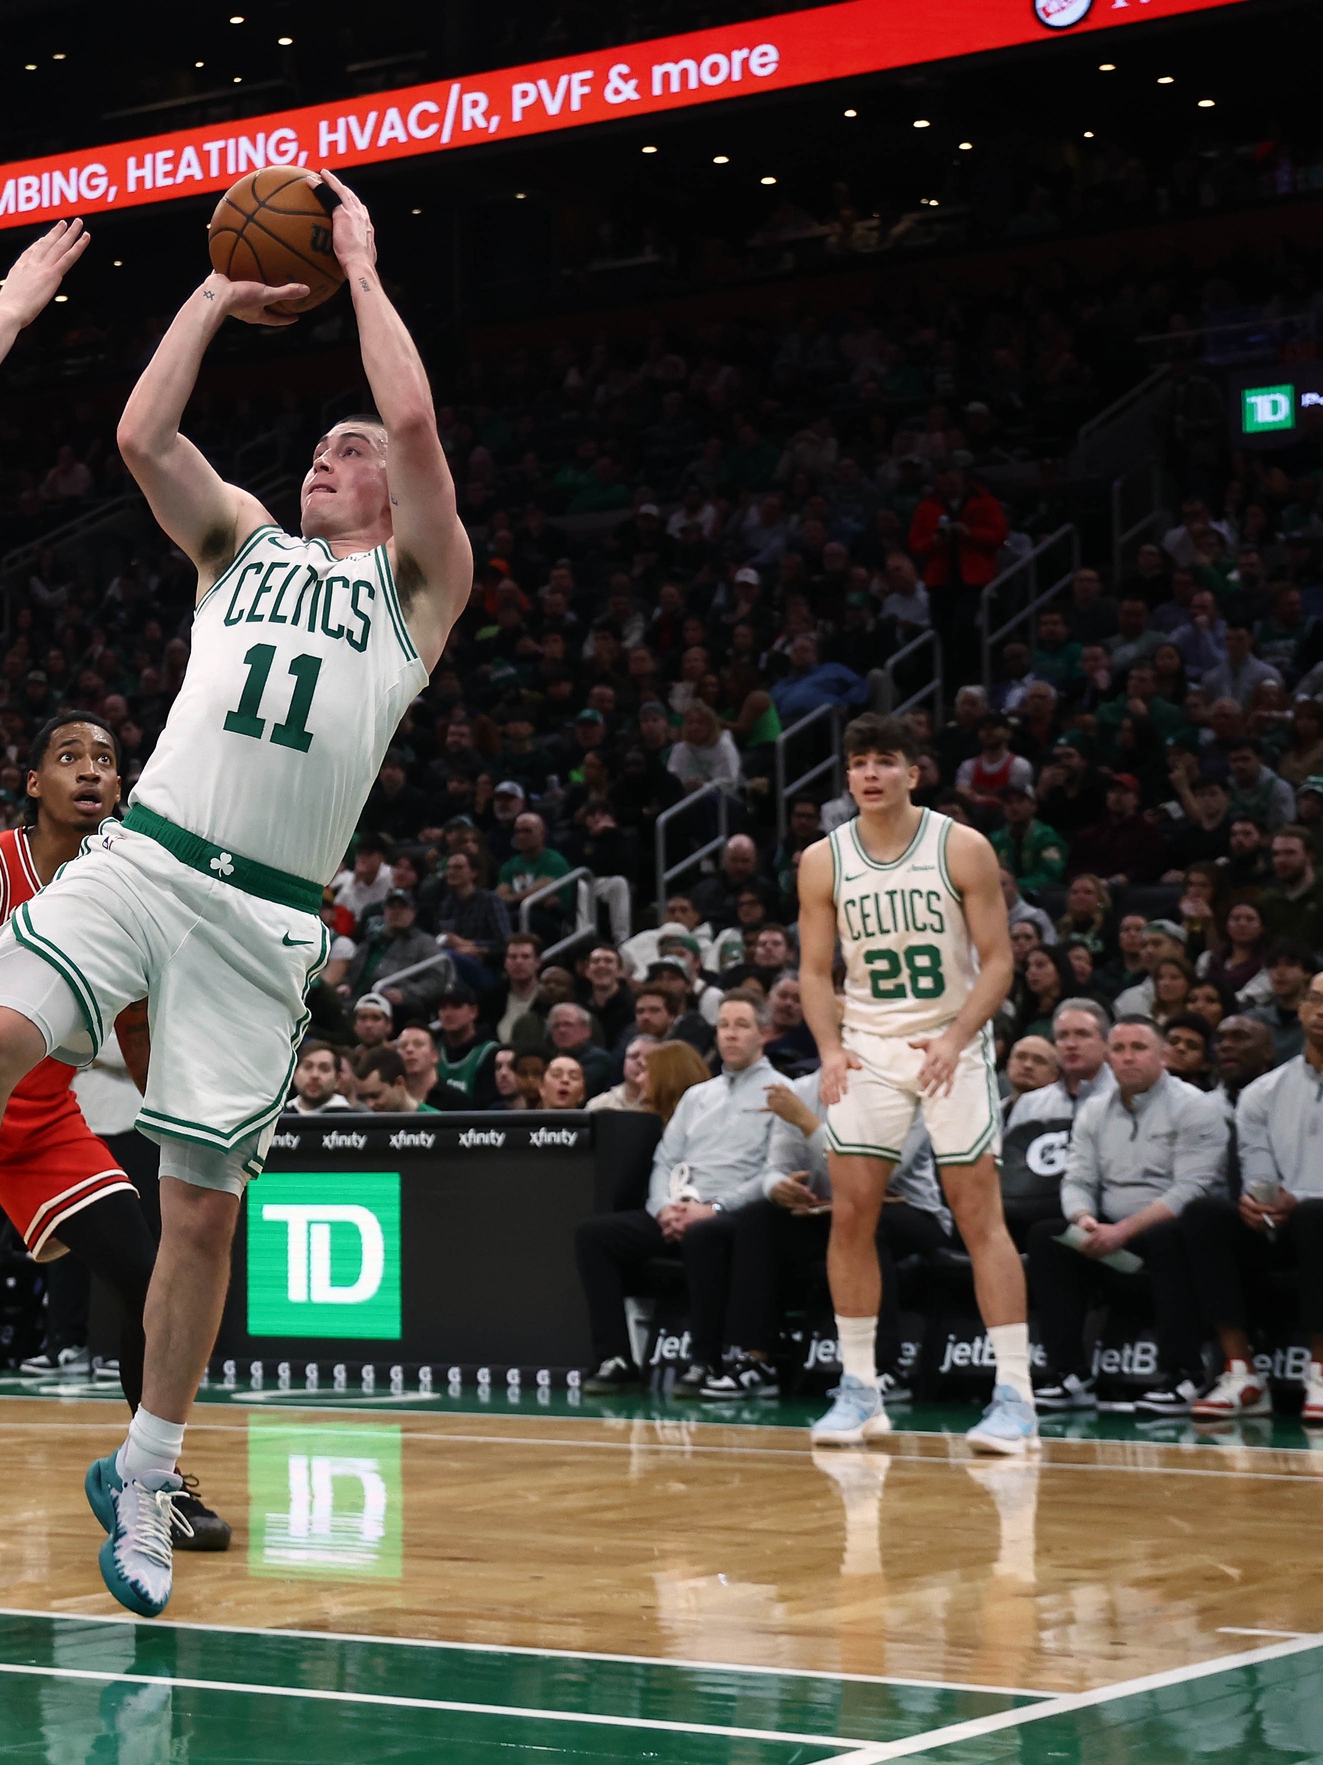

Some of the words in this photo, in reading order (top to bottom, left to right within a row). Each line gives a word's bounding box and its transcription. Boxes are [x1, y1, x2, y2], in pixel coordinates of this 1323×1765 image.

[126, 128, 308, 193] HEATING,
[318, 83, 501, 158] HVAC/R,
[511, 70, 594, 122] PVF
[603, 63, 641, 104] &
[651, 43, 779, 96] more
[1246, 393, 1290, 423] TD
[223, 562, 376, 653] CELTICS
[223, 643, 323, 753] 11
[844, 889, 945, 941] CELTICS
[864, 944, 946, 999] 28
[322, 1130, 368, 1150] xfinity
[389, 1129, 435, 1149] xfinity
[458, 1128, 506, 1148] xfinity
[529, 1127, 578, 1147] xfinity
[262, 1204, 385, 1304] TD
[1249, 1345, 1313, 1380] etB
